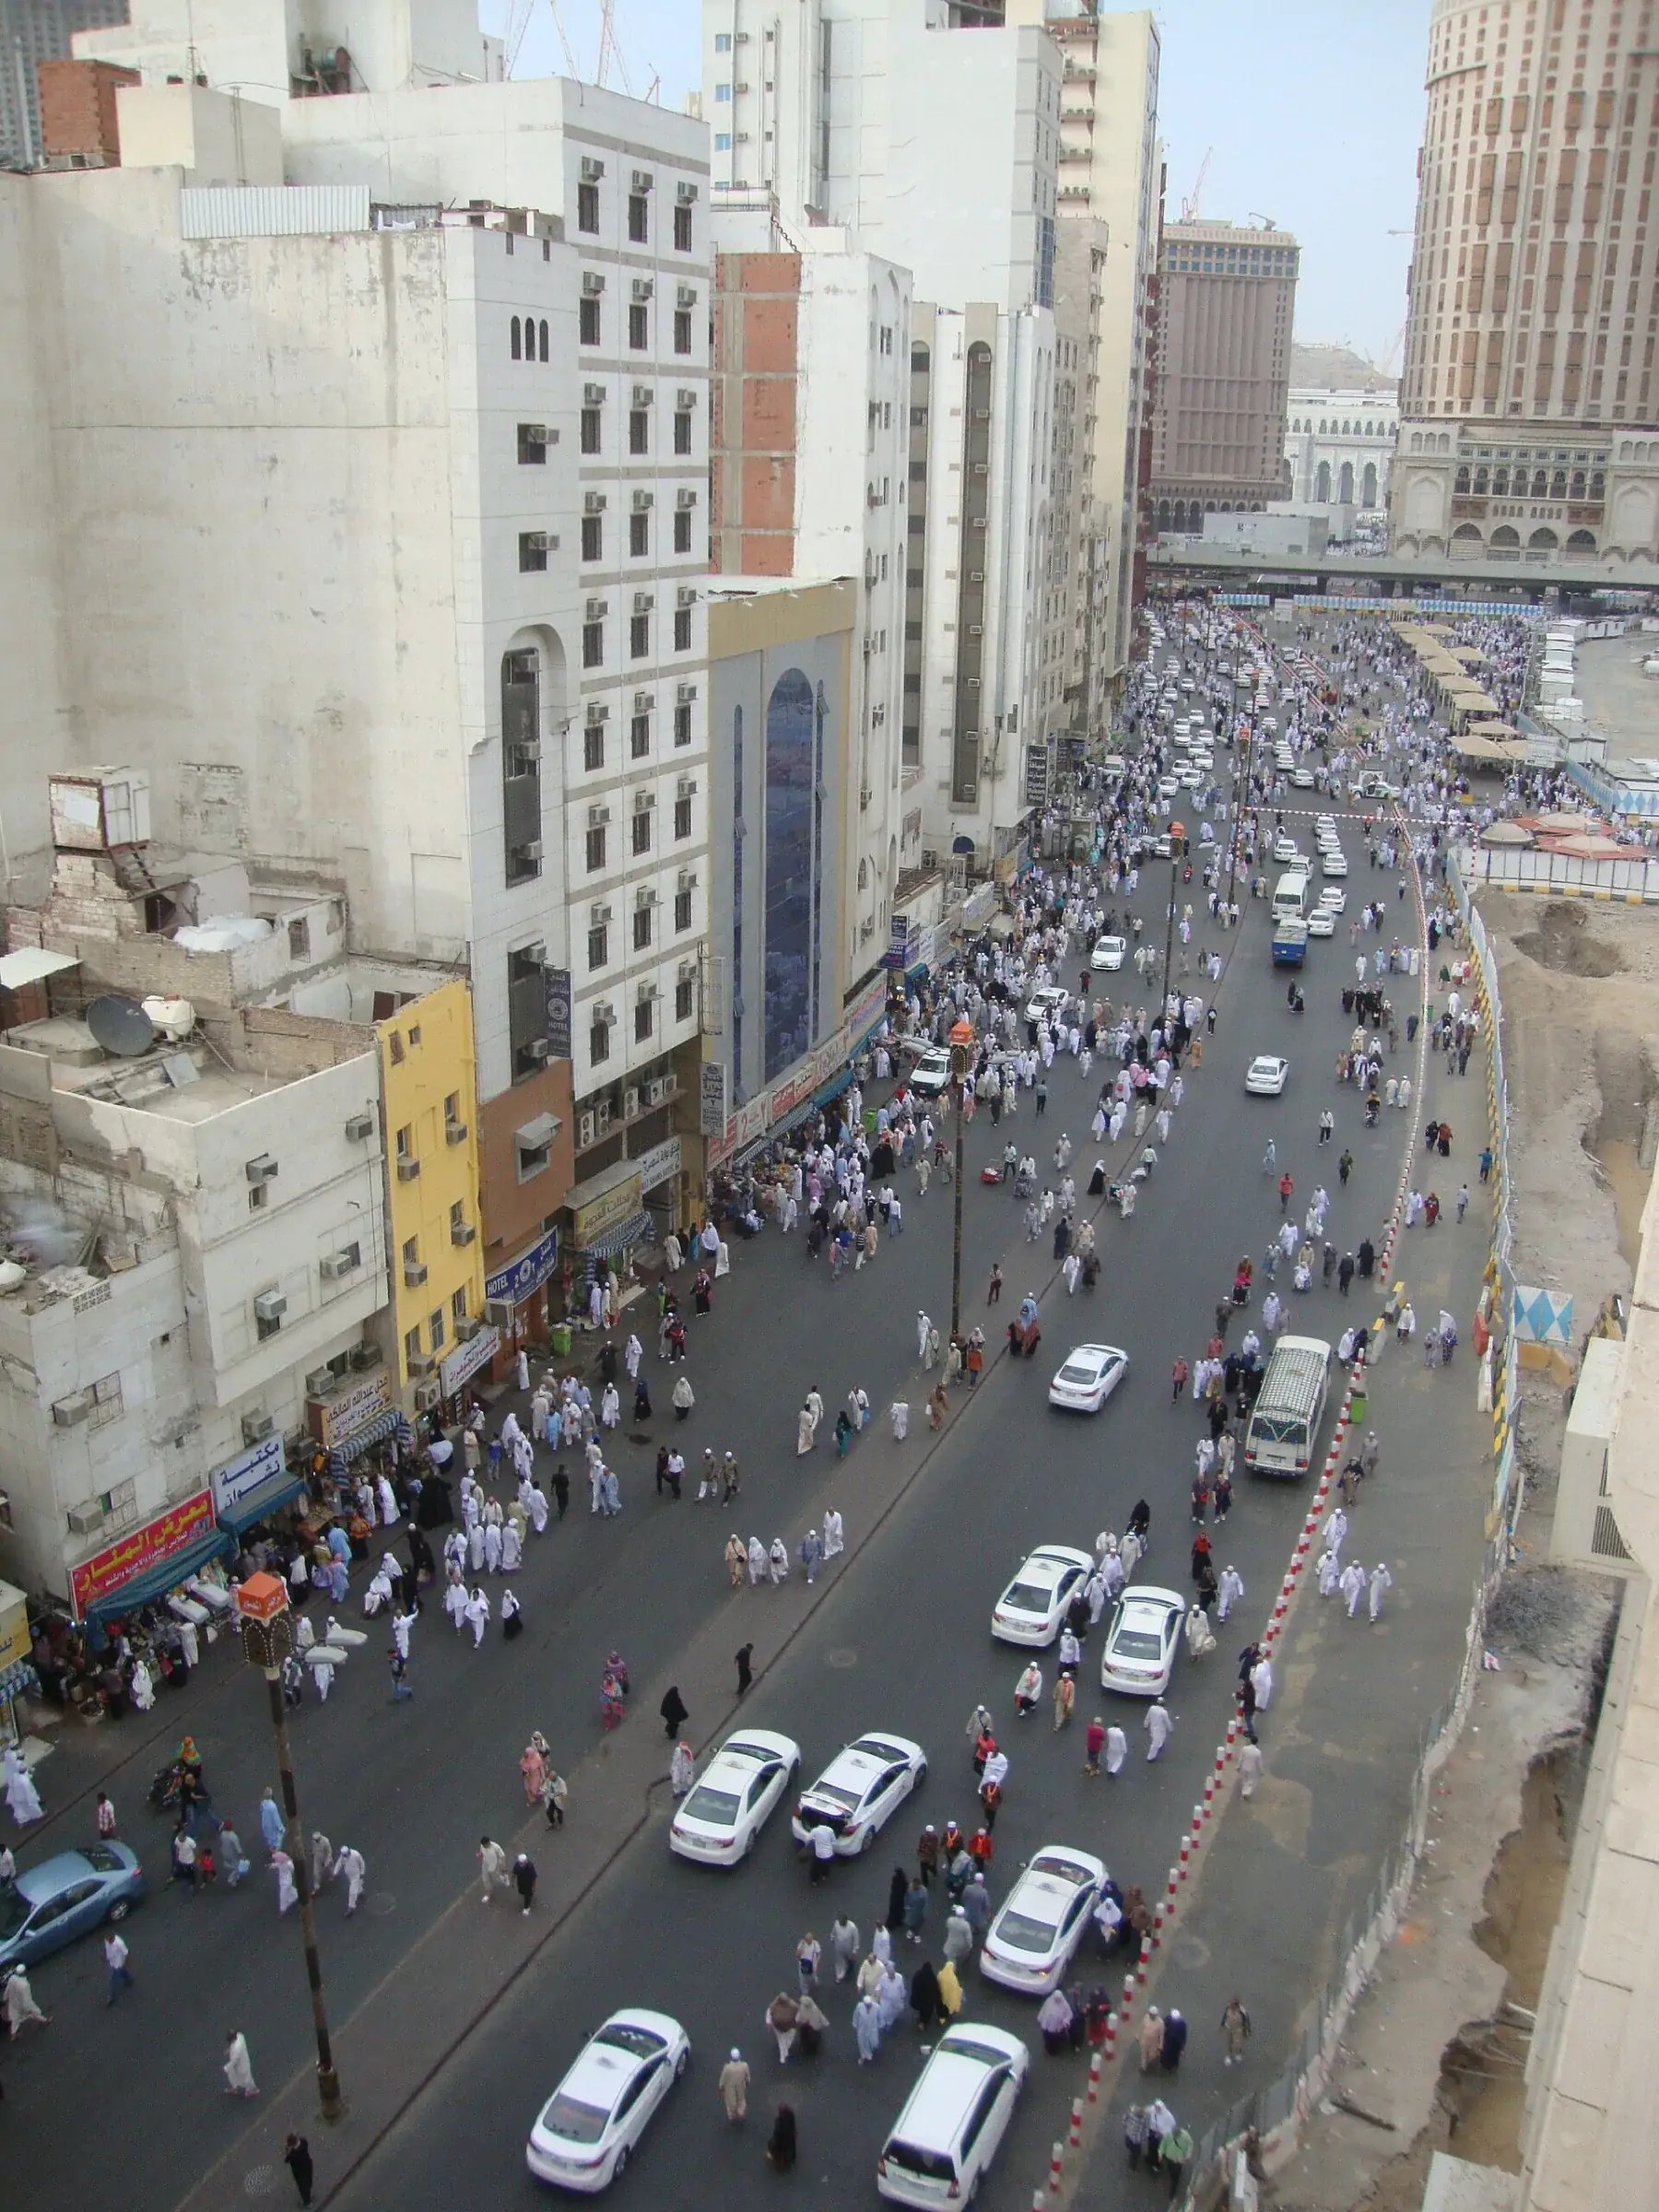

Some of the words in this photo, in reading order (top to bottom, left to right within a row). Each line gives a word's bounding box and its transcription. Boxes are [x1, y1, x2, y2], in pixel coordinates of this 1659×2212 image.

[547, 1021, 568, 1030] HOTEL
[487, 1274, 509, 1296] HOTEL
[352, 1384, 374, 1406] عبدالله
[374, 1376, 388, 1394] محل
[326, 1395, 351, 1423] المالكي
[219, 1442, 279, 1486] مكتبة
[225, 1460, 280, 1510] نشوان
[154, 1499, 208, 1547] معرض
